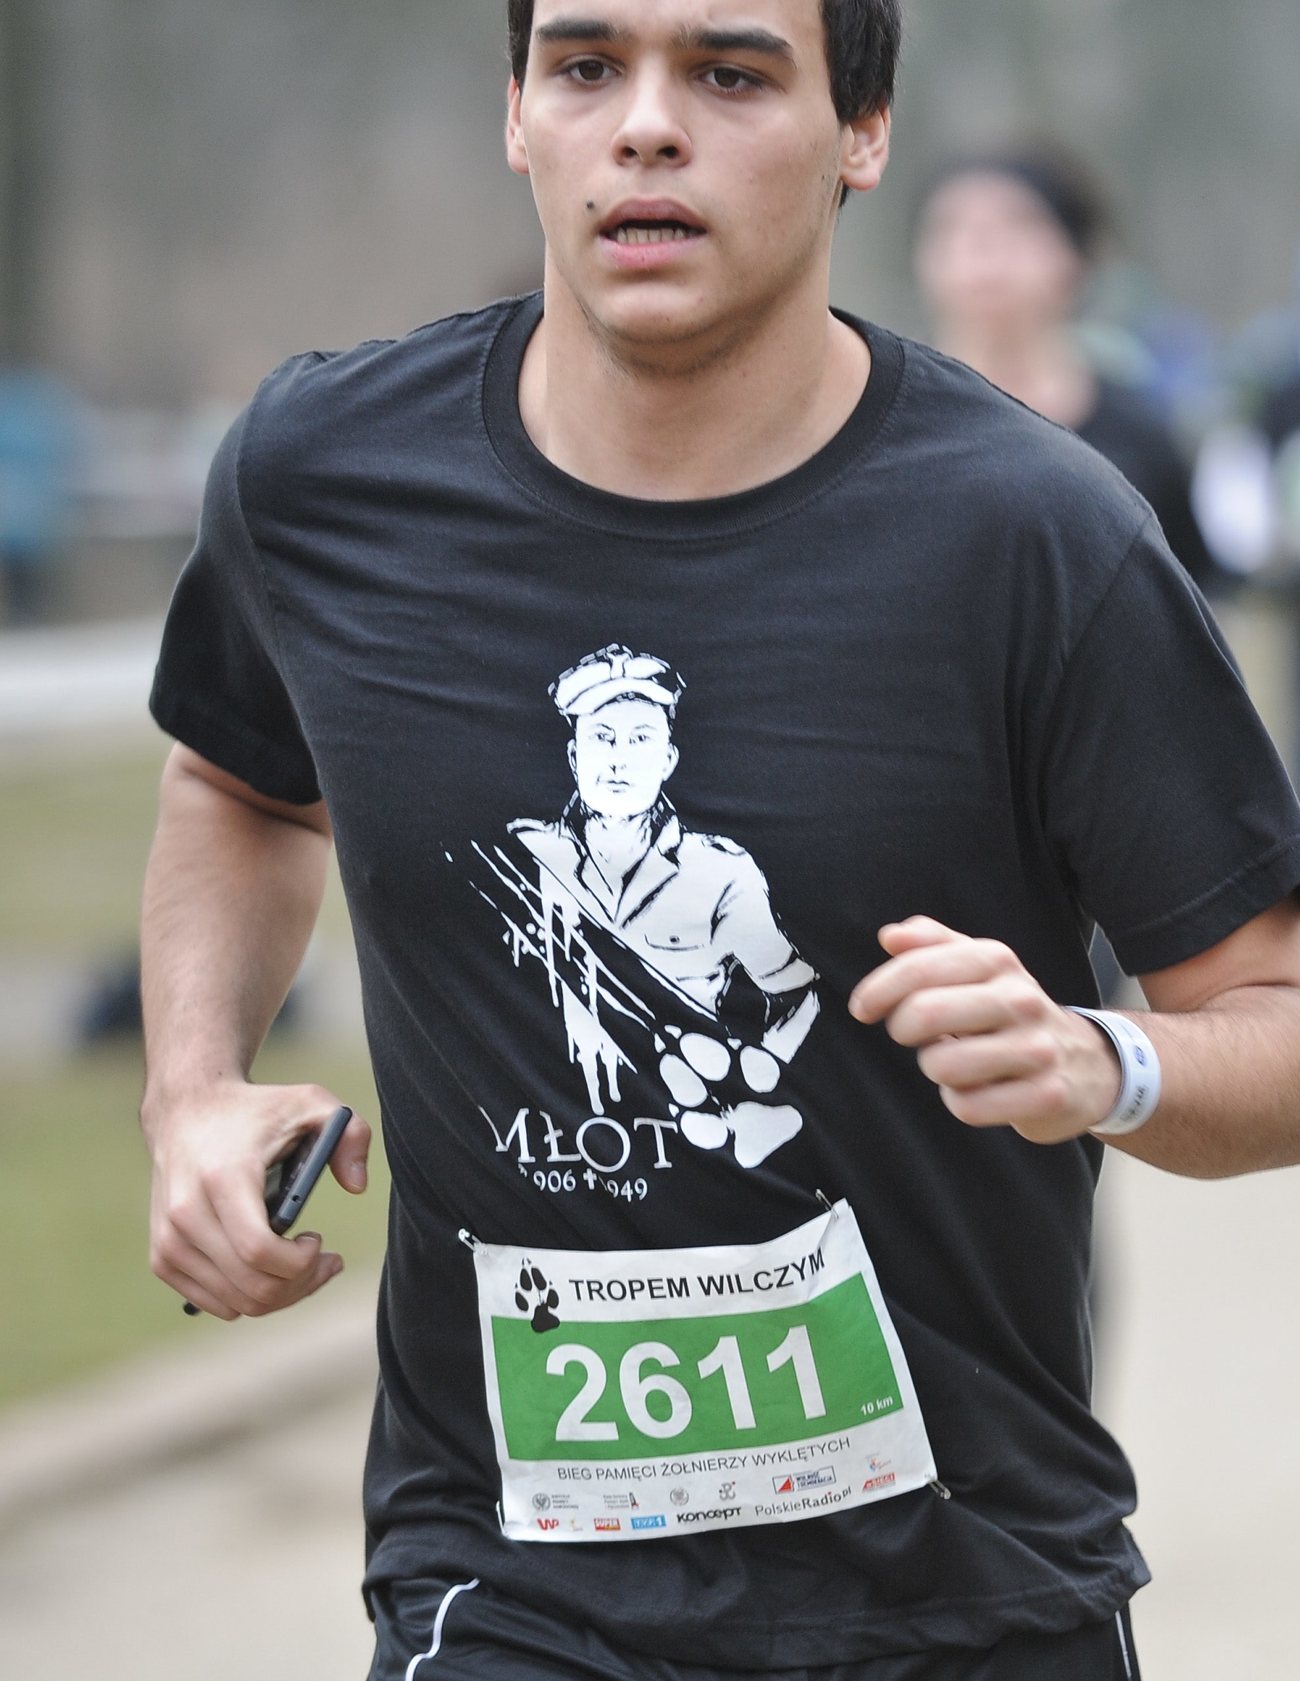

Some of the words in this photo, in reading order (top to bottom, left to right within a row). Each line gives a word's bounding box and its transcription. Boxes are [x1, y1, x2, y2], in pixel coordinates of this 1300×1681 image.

[477, 1107, 679, 1173] MŁOT
[568, 1276, 691, 1302] TROPEM
[696, 1246, 826, 1297] WILCZYM
[545, 1324, 827, 1443] 2611
[860, 1403, 875, 1416] 10
[876, 1396, 894, 1410] km
[557, 1467, 592, 1480] BIEG
[595, 1465, 657, 1482] PAMIĘCI
[661, 1454, 748, 1477] ŻOŁNIERZY
[751, 1436, 851, 1467] WYKLĘTYCH
